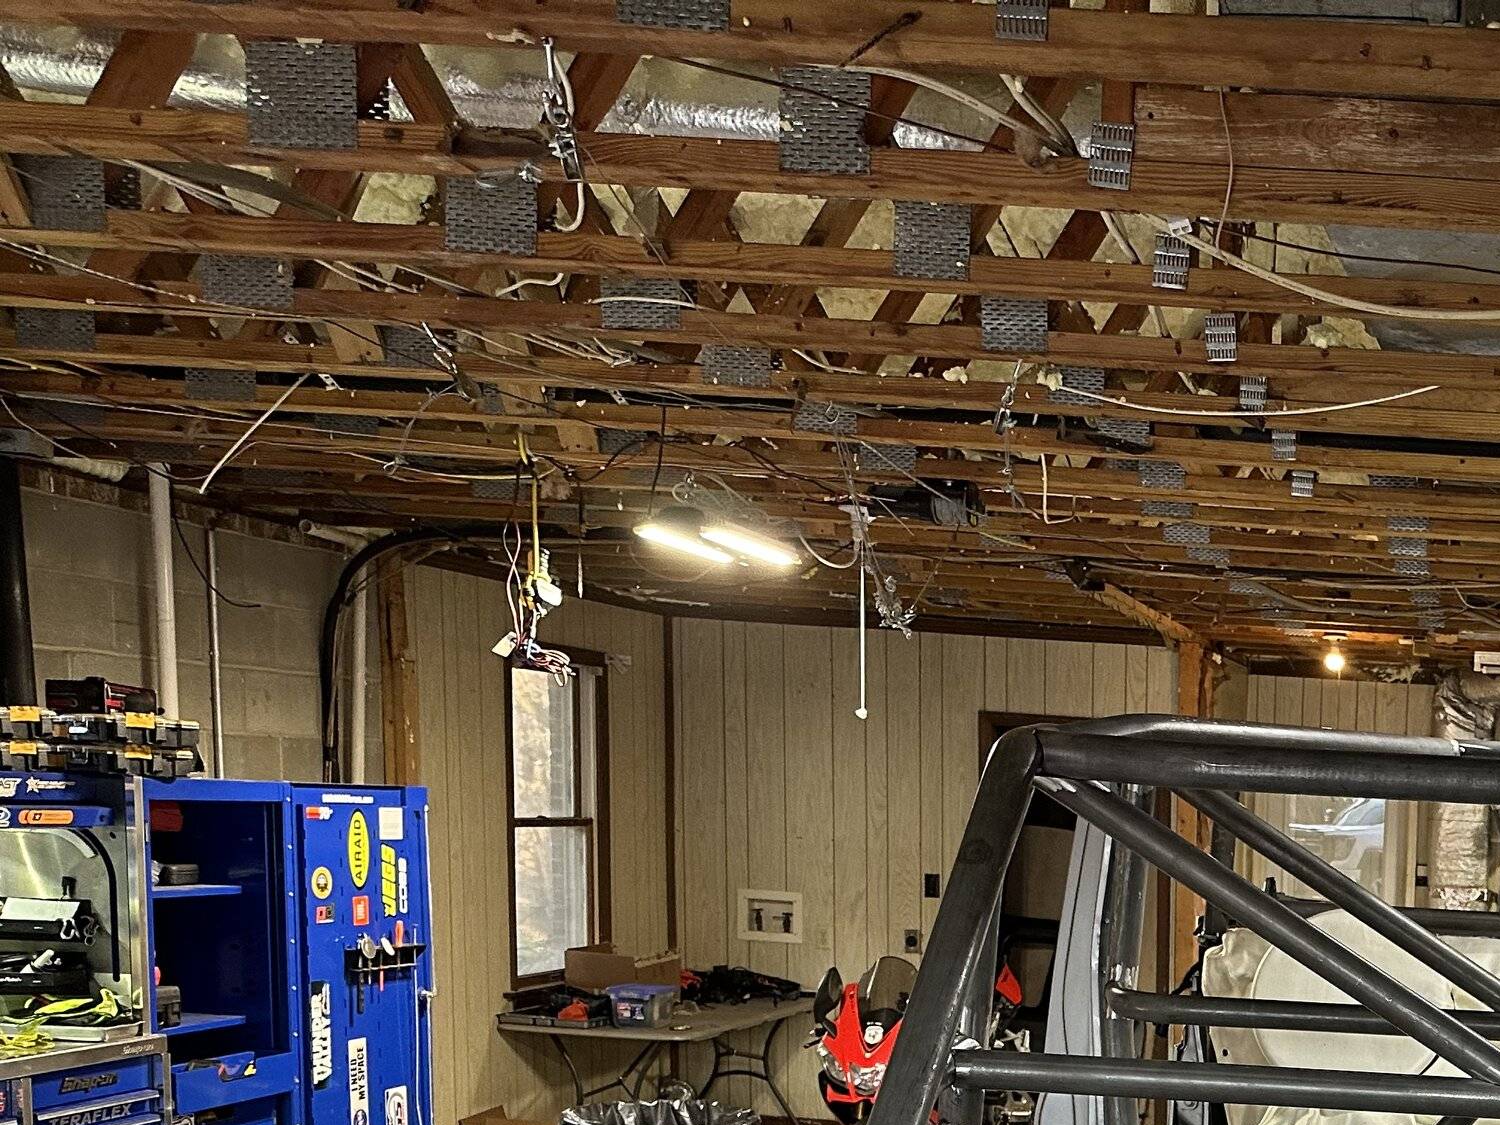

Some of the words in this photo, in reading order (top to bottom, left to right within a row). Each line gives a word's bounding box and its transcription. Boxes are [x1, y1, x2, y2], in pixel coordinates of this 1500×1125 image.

[353, 819, 362, 881] AIRAID
[381, 843, 397, 917] JEGS
[350, 1058, 358, 1084] NEED
[357, 1047, 365, 1082] SPACE
[358, 1085, 365, 1100] MY
